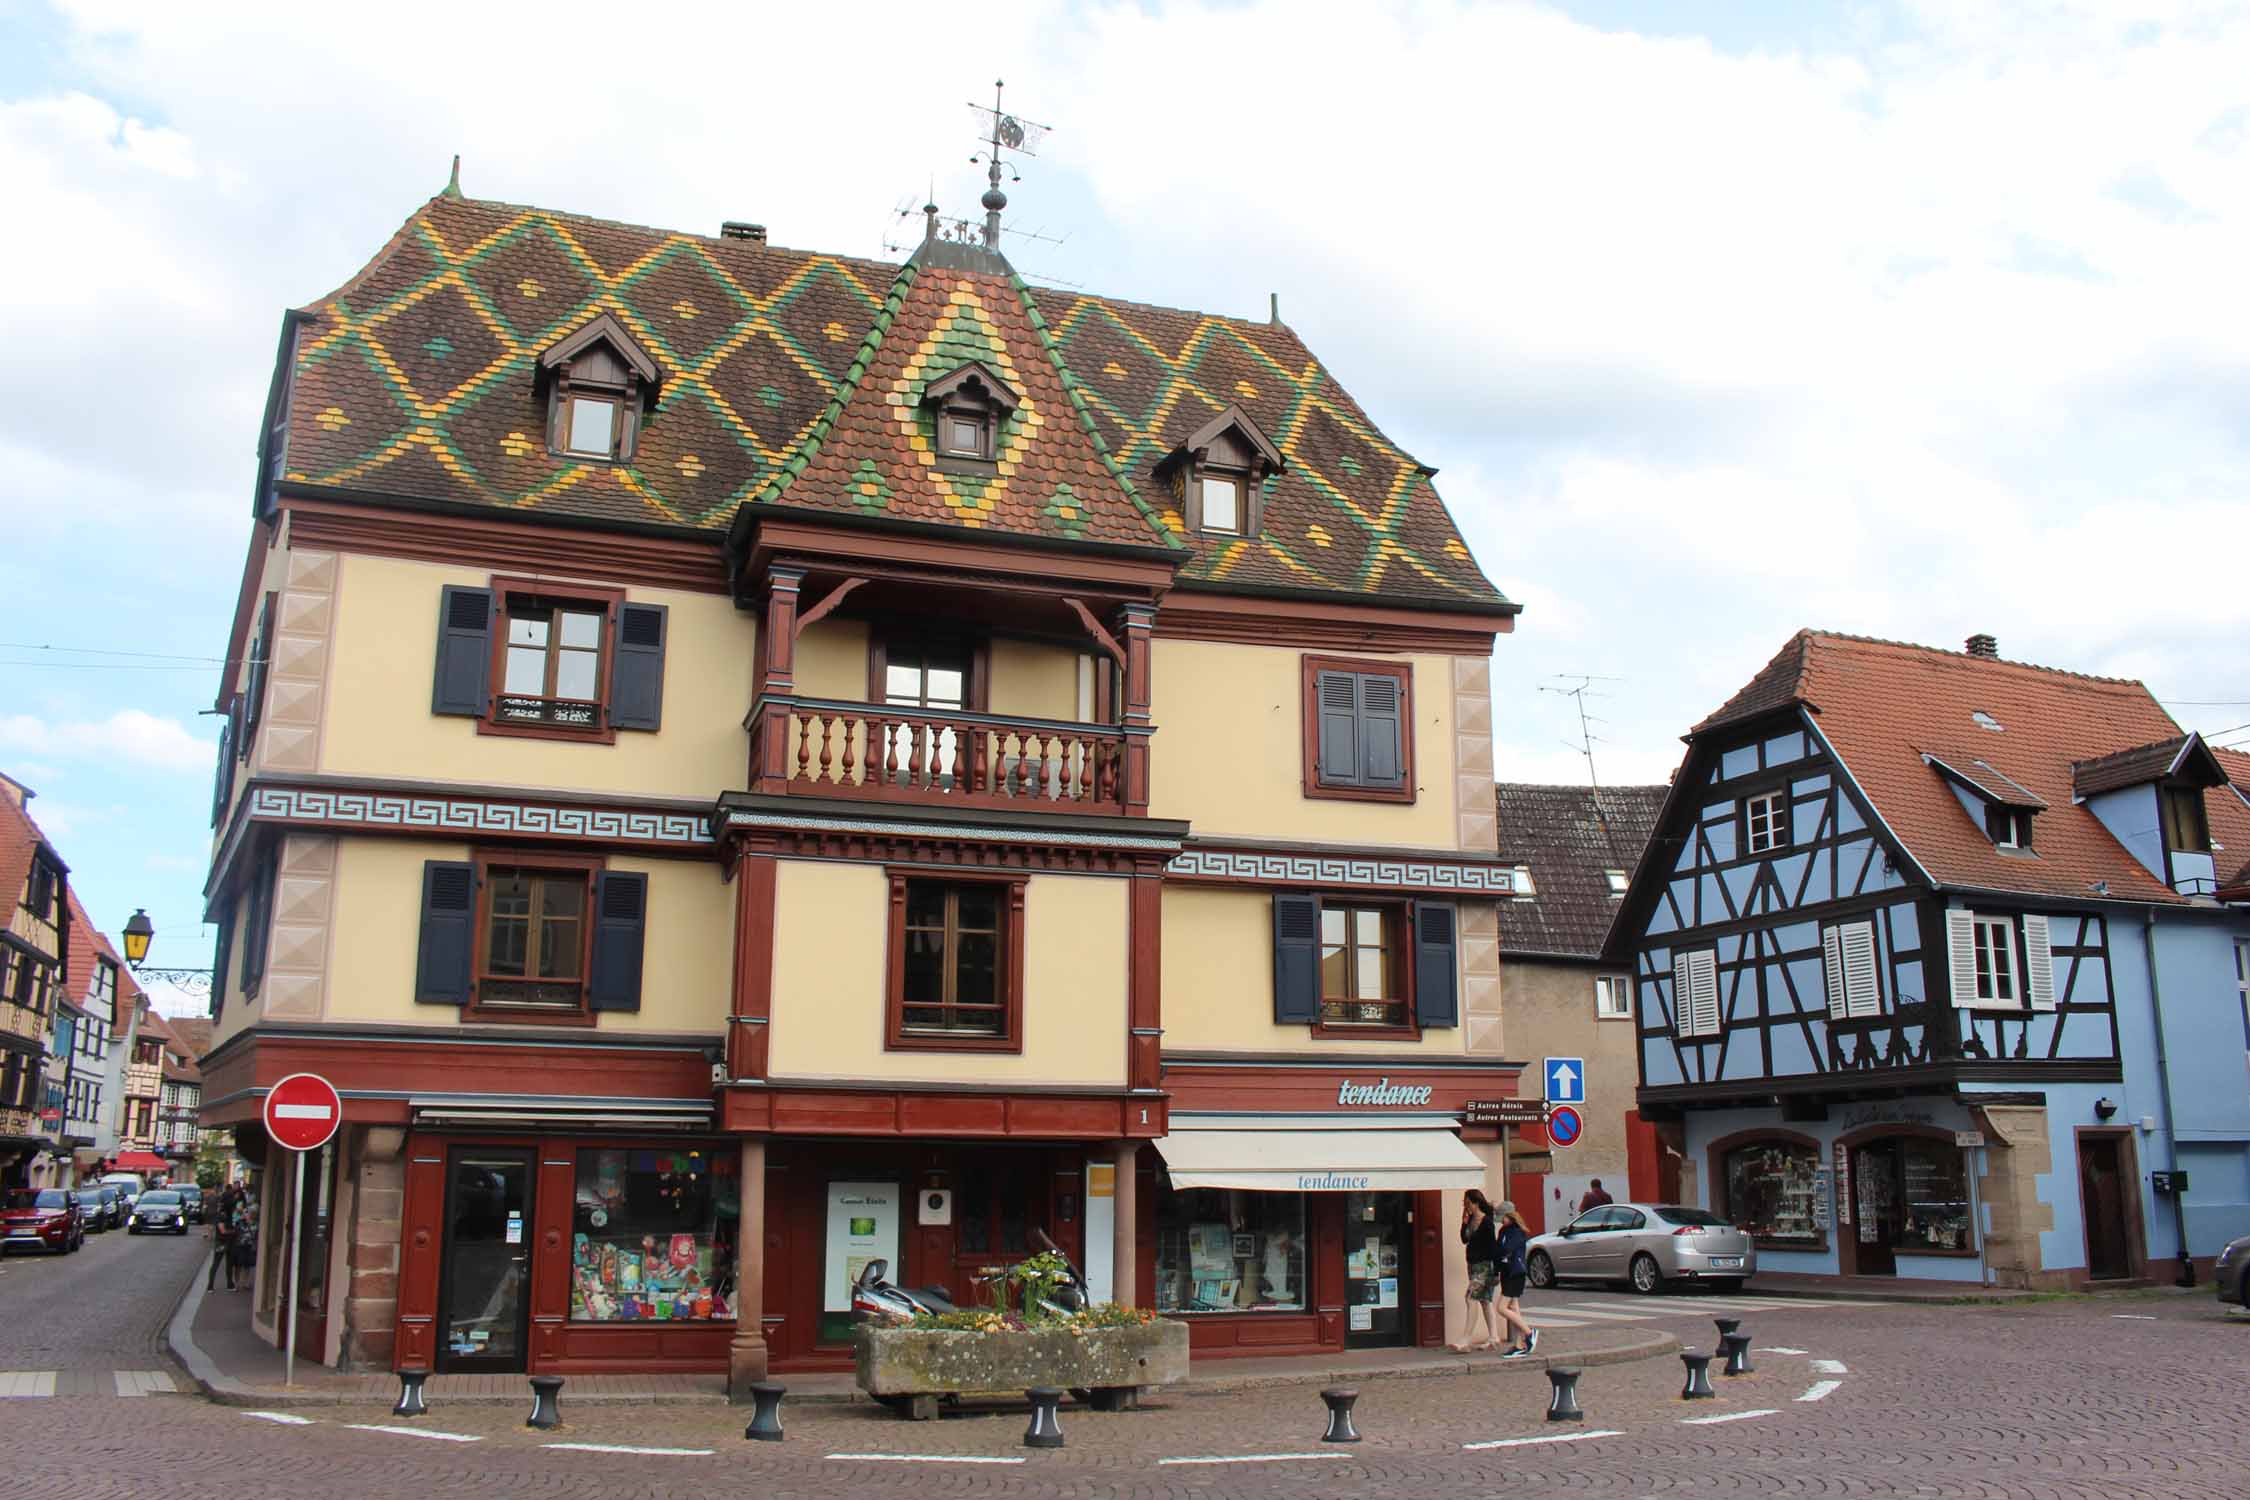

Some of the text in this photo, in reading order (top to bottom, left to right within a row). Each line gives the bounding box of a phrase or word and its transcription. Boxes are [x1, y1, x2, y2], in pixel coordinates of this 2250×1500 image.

[1338, 1076, 1432, 1105] tendance
[1501, 1102, 1523, 1110] Hôtels
[1140, 1108, 1149, 1124] 1
[1476, 1113, 1538, 1121] Autres Restaurants
[1297, 1171, 1369, 1190] tendance
